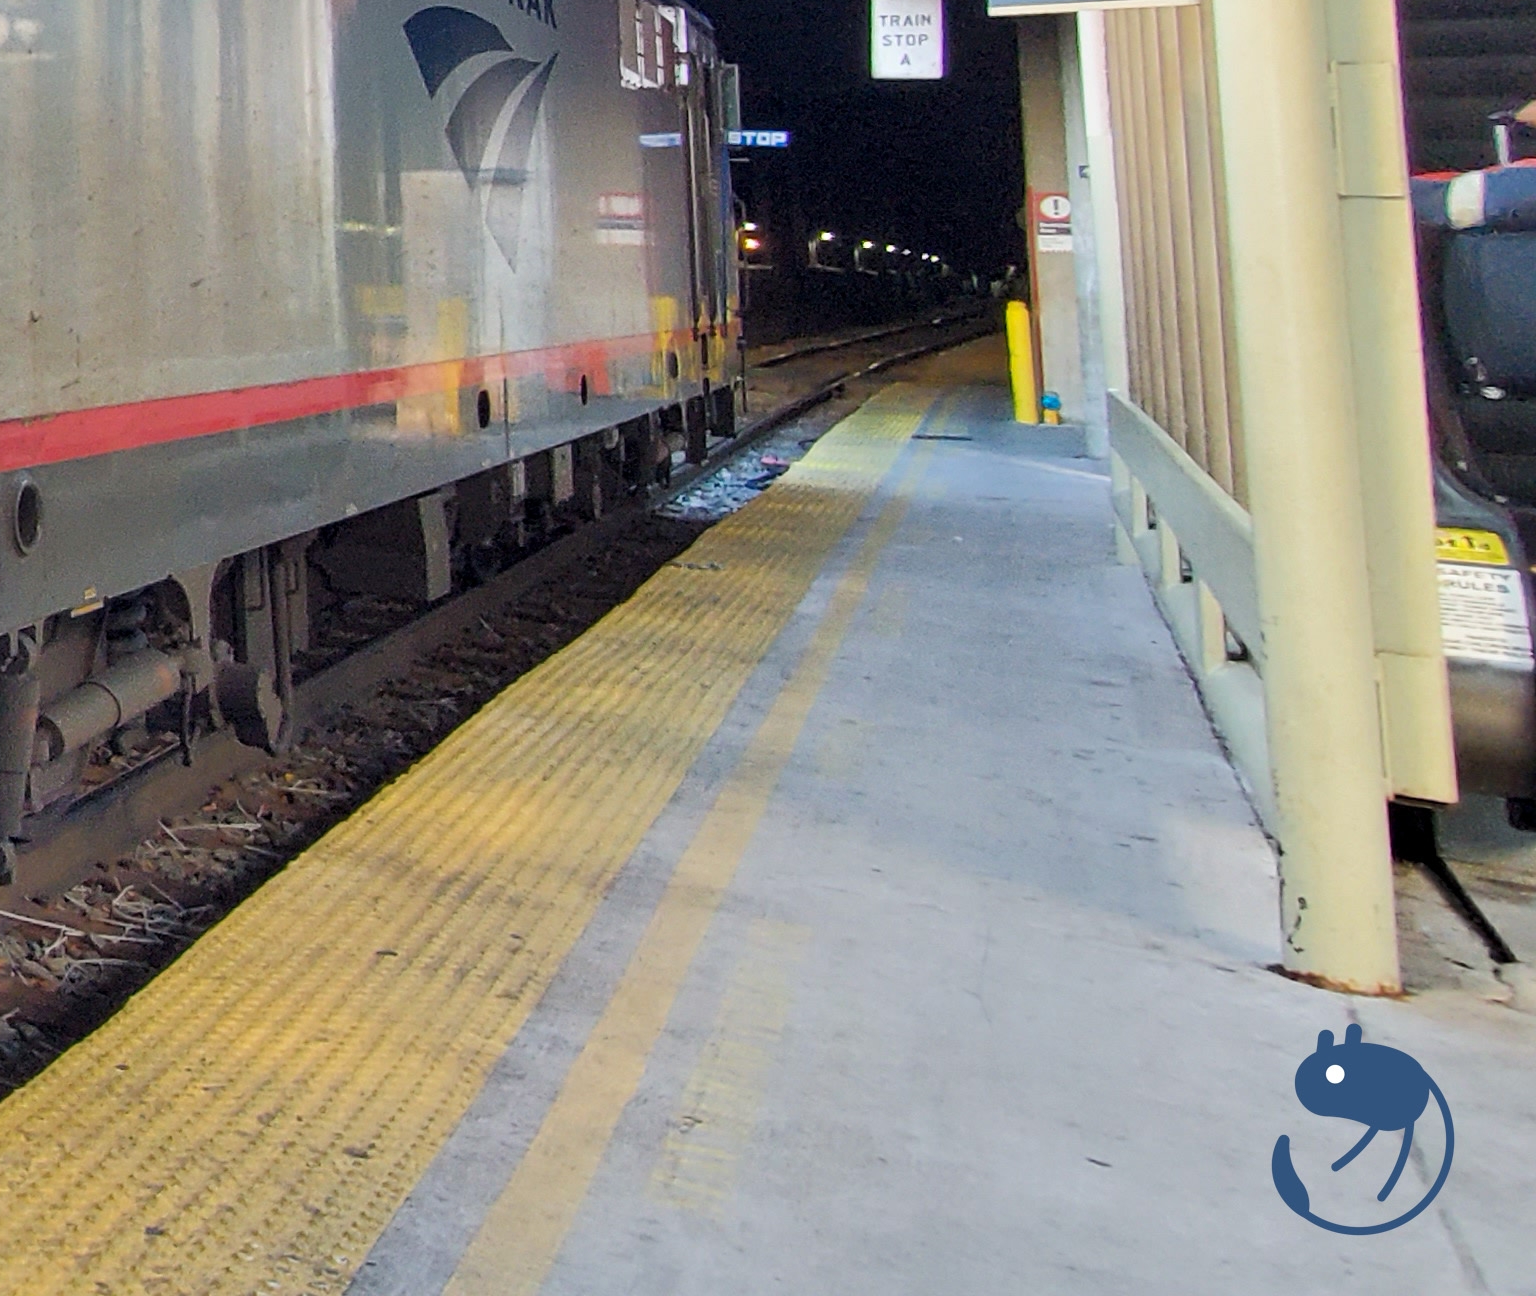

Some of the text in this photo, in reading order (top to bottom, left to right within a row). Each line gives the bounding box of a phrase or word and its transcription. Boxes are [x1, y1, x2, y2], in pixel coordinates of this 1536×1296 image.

[879, 14, 932, 27] TRAIN
[882, 33, 929, 47] STOP
[900, 53, 911, 66] A
